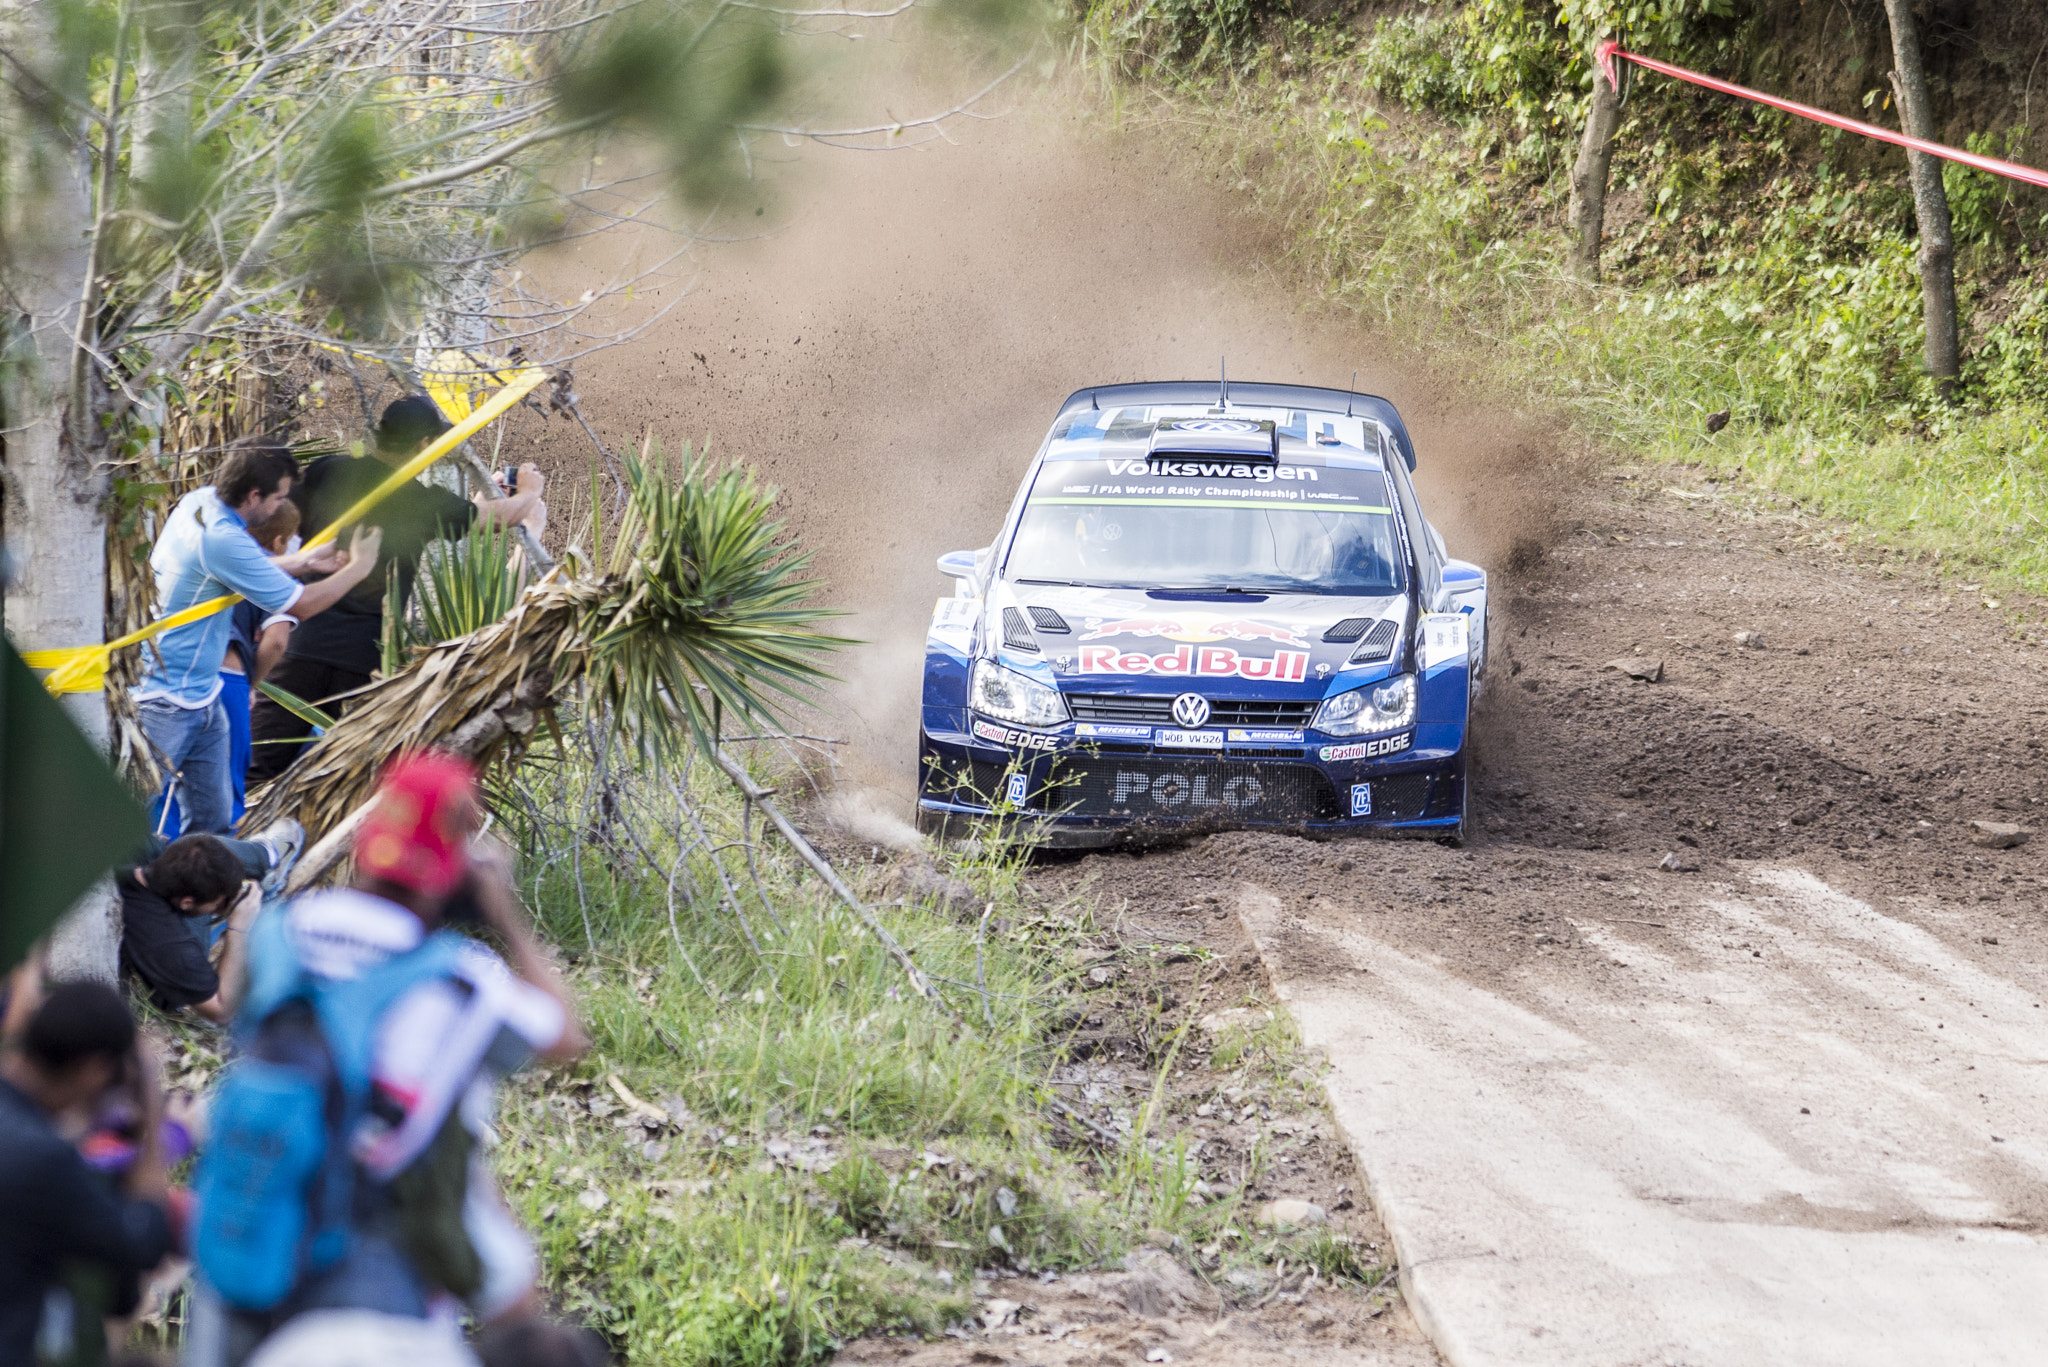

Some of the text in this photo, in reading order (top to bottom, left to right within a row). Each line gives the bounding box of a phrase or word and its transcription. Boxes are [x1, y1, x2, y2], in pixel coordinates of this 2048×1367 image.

[1106, 459, 1318, 482] Volkswagen
[1100, 485, 1298, 499] FIA World Rally Championship
[1081, 646, 1306, 680] Red Bull
[979, 724, 1060, 751] Castrol EDGE
[1098, 727, 1149, 735] MICHELIN
[1251, 732, 1302, 740] MICHELIN
[1331, 732, 1410, 759] Castrol EDGE
[1113, 772, 1262, 807] POLO
